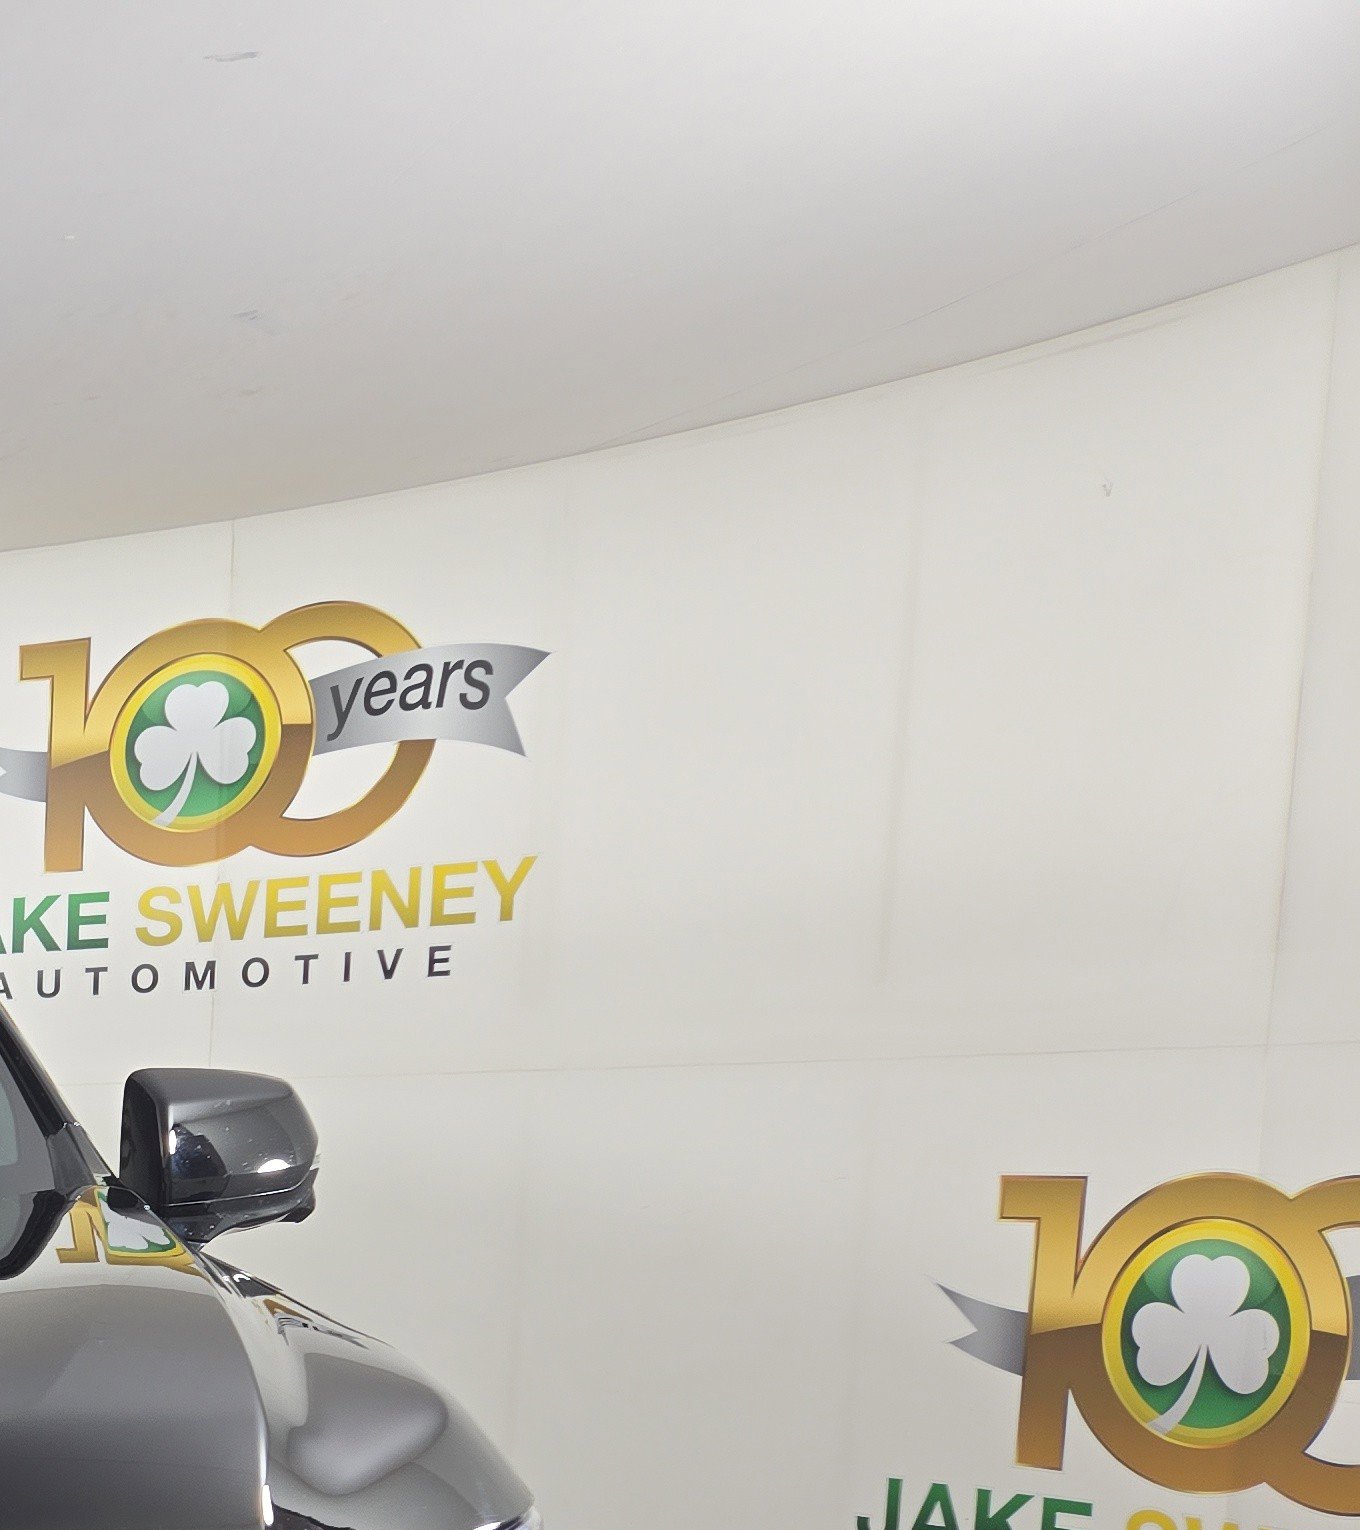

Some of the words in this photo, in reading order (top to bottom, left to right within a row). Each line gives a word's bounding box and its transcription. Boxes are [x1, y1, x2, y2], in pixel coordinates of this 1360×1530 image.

[19, 600, 437, 874] 100
[327, 658, 494, 741] years
[135, 856, 537, 946] SWEENEY
